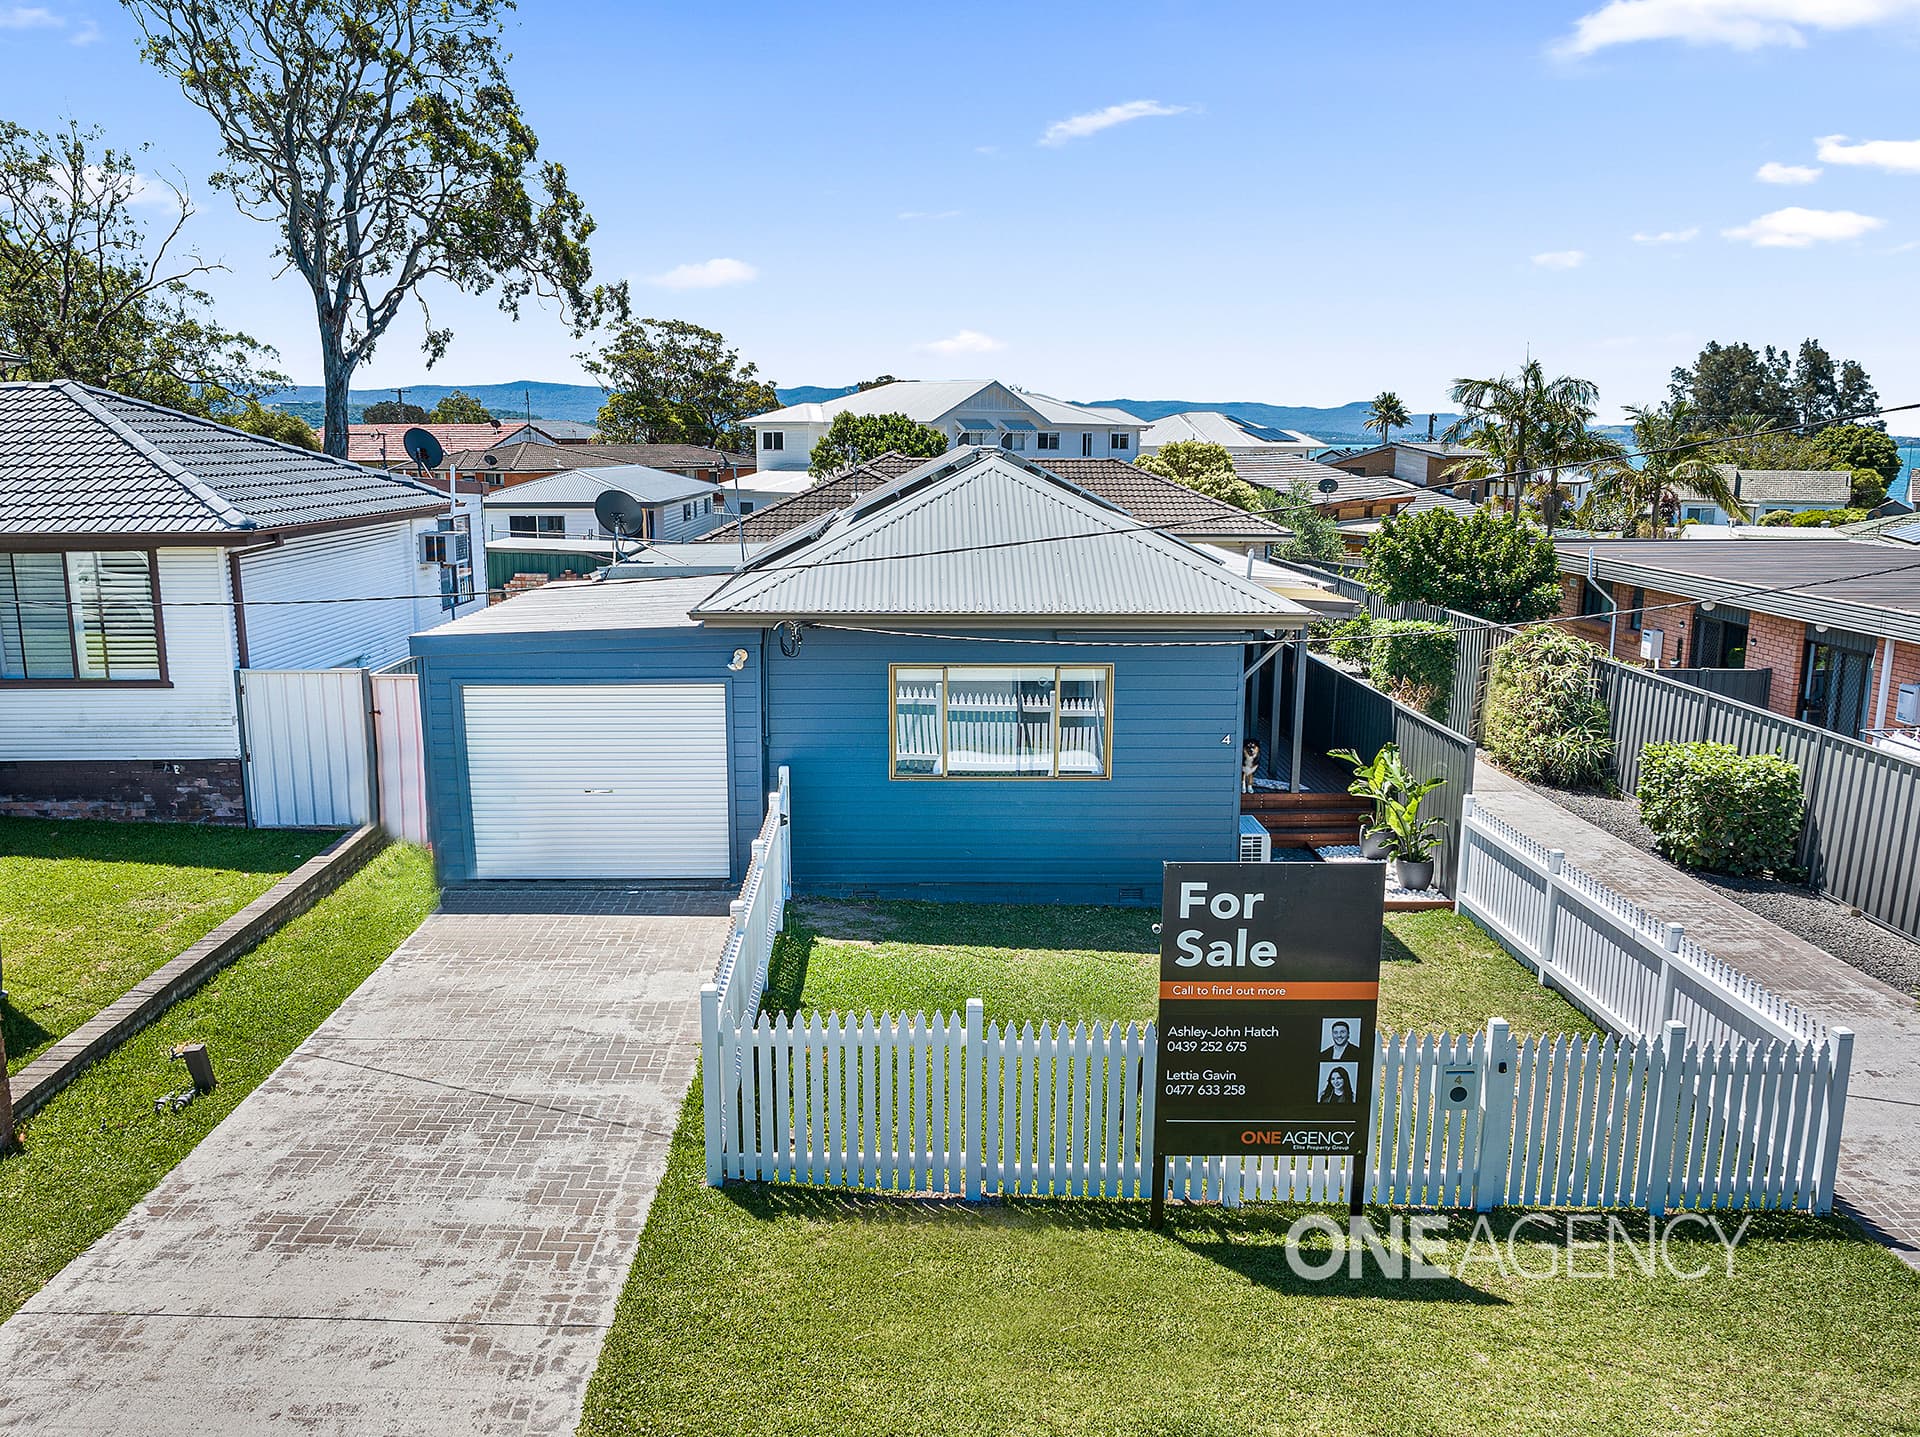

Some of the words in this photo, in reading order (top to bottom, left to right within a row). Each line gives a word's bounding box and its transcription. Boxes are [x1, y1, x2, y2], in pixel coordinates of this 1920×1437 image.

[1220, 734, 1232, 745] 4
[1179, 881, 1265, 920] For
[1174, 928, 1278, 968] Sale
[1172, 985, 1194, 995] Call
[1197, 986, 1209, 995] to
[1212, 985, 1233, 995] find
[1235, 986, 1255, 995] out
[1167, 1026, 1241, 1040] Ashley-John
[1244, 1026, 1279, 1037] Hatch
[1167, 1041, 1198, 1052] 0439
[1200, 1041, 1223, 1052] 252
[1225, 1041, 1247, 1052] 675
[1166, 1069, 1200, 1080] Lettia
[1202, 1069, 1237, 1080] Gavin
[1454, 1075, 1463, 1085] 4
[1165, 1084, 1194, 1096] 0477
[1197, 1084, 1220, 1096] 633
[1223, 1084, 1246, 1096] 258
